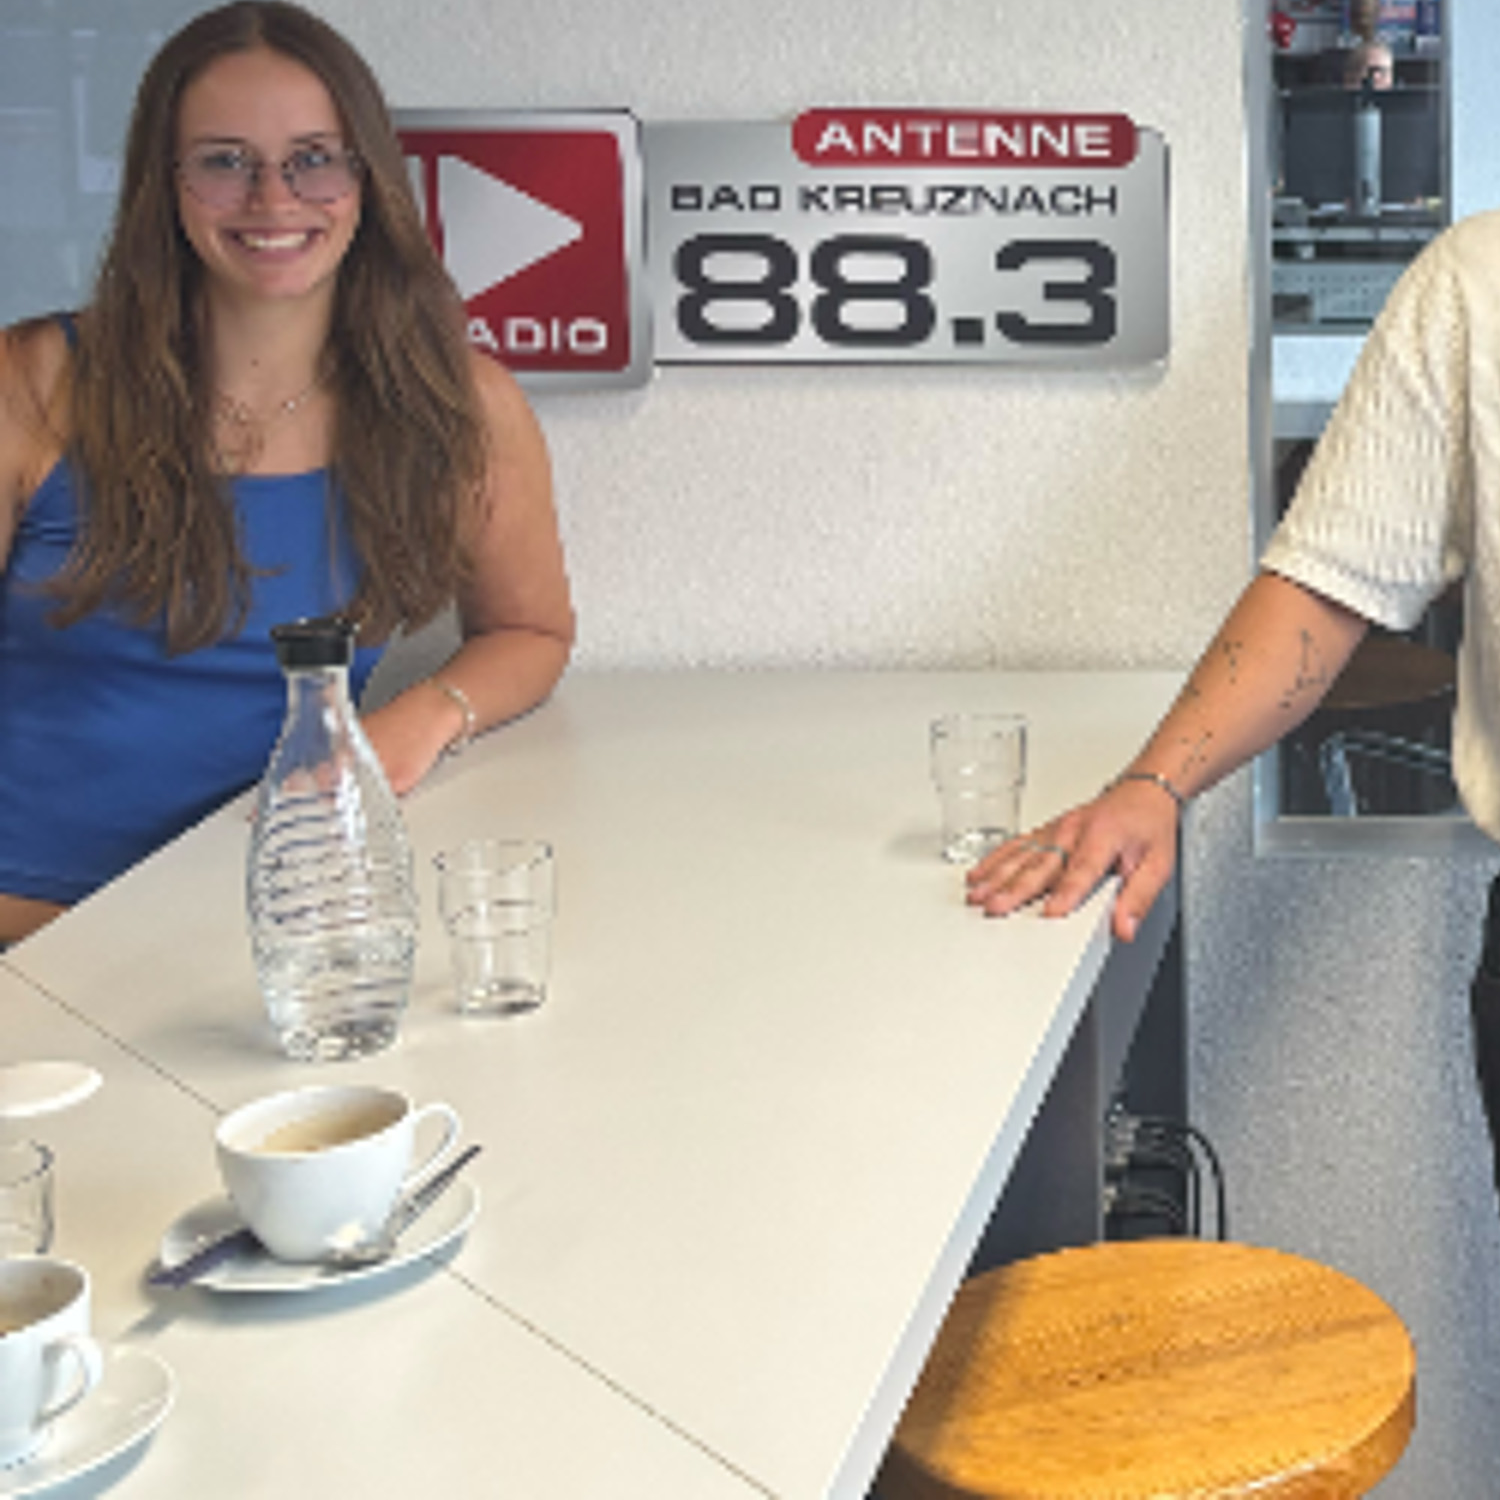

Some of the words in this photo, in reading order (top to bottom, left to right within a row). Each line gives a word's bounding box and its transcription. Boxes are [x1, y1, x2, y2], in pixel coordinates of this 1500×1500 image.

[816, 123, 1112, 157] ANTENNE
[671, 185, 782, 213] BAD
[799, 185, 1118, 216] KREUZNACH
[673, 233, 1118, 348] 88.3
[465, 317, 610, 353] ADIO
